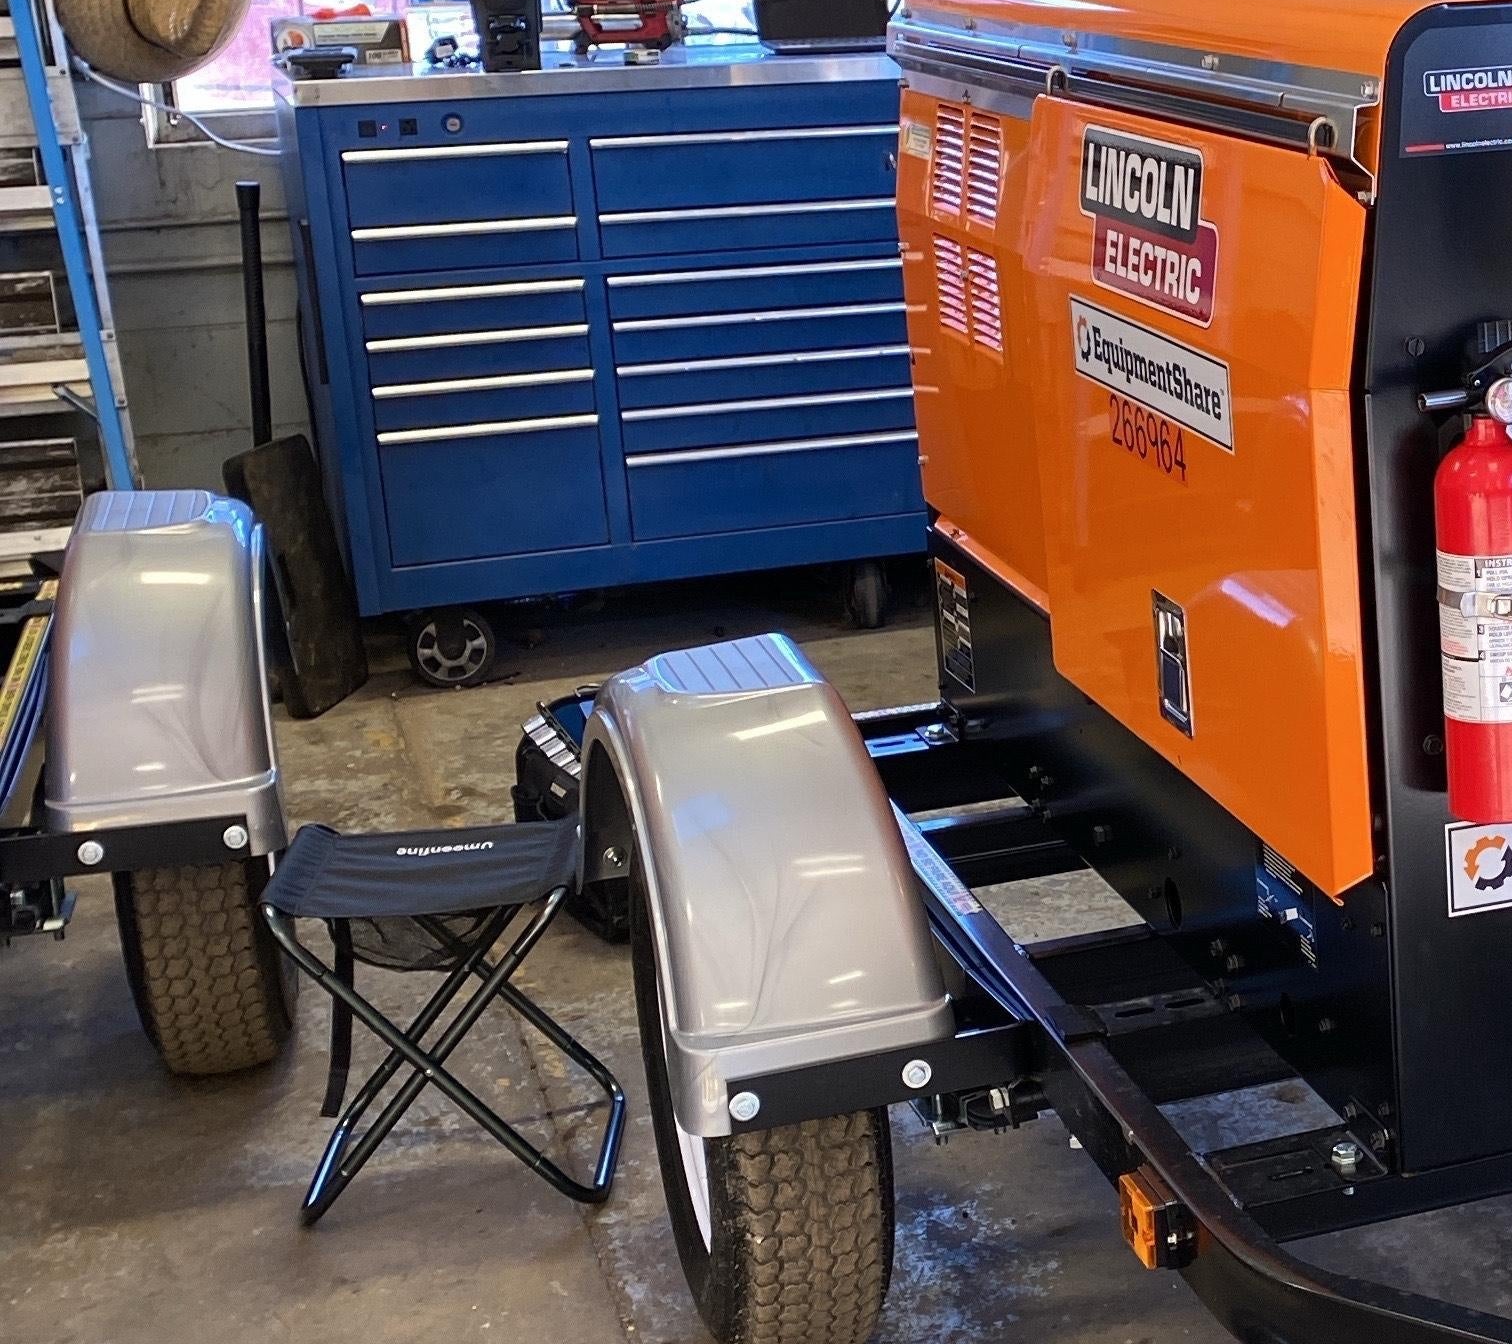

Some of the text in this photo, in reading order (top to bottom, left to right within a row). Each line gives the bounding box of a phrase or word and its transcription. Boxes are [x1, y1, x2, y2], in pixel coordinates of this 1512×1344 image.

[1429, 70, 1512, 93] LINCOLN
[1085, 142, 1195, 231] LINCOLN
[1104, 228, 1202, 305] ELECTRIC
[1091, 325, 1222, 421] EquipmentShare
[1109, 393, 1187, 482] 266964
